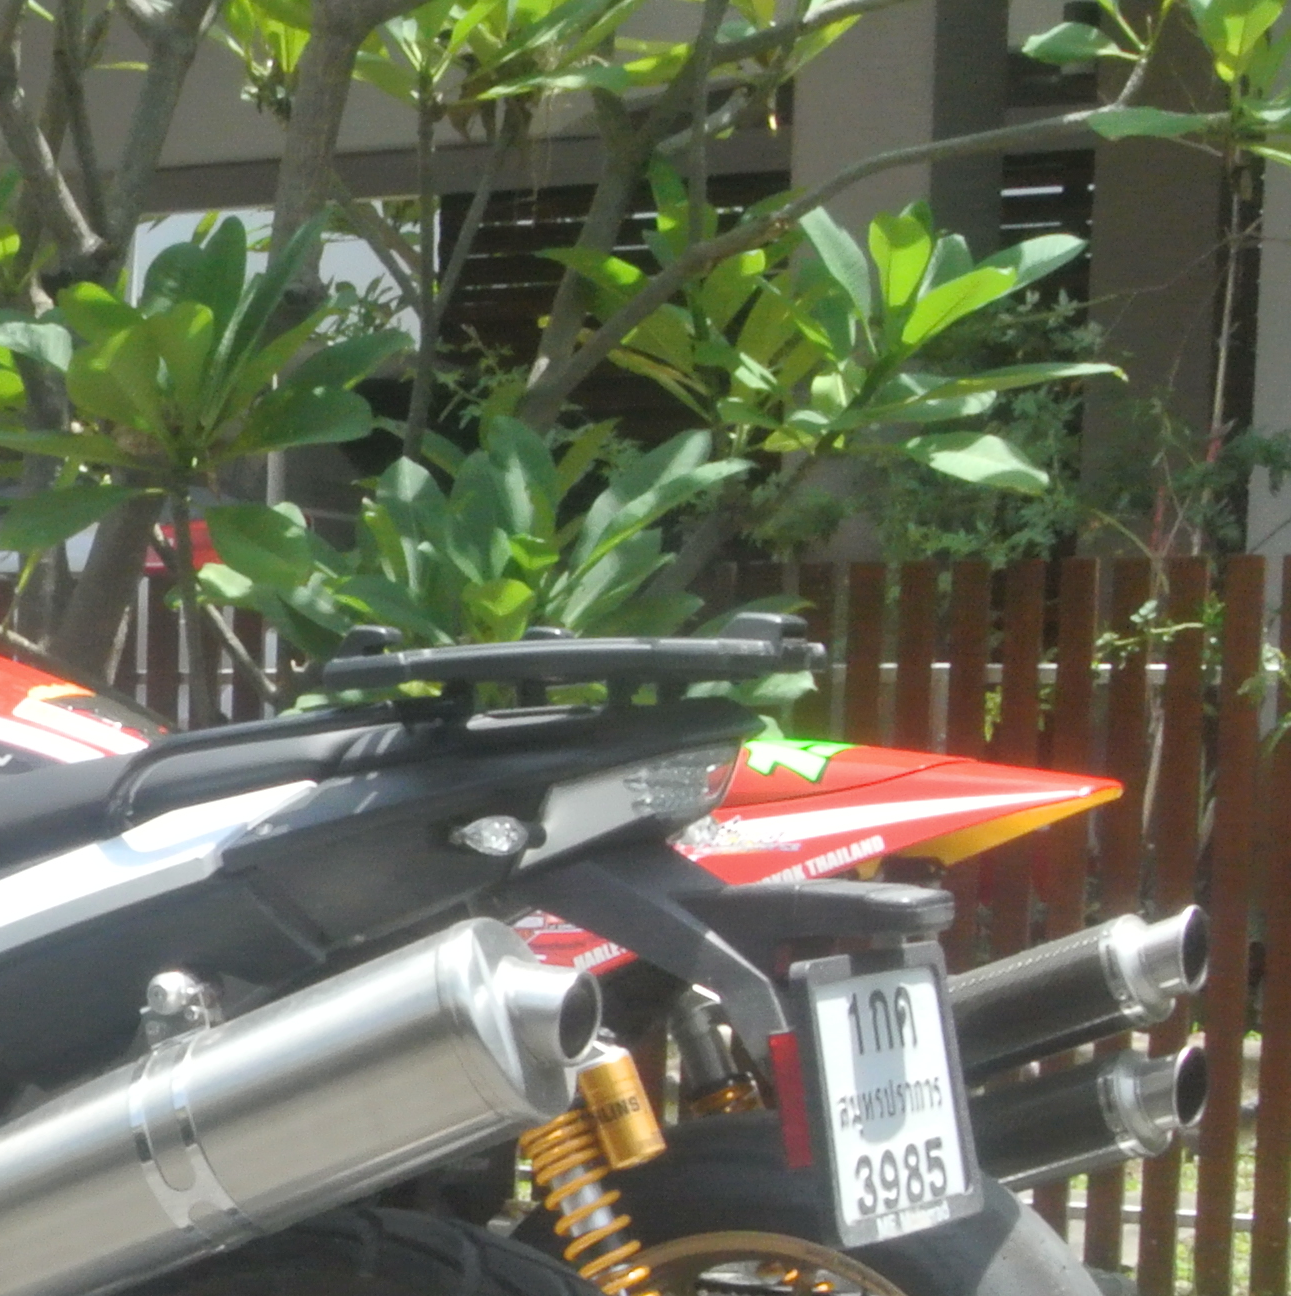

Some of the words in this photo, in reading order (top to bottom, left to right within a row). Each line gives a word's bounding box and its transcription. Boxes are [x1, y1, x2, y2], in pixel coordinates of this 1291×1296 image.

[805, 834, 886, 878] THAILAND
[837, 1076, 943, 1138] สมุทรปราการ
[854, 1136, 947, 1217] 3985
